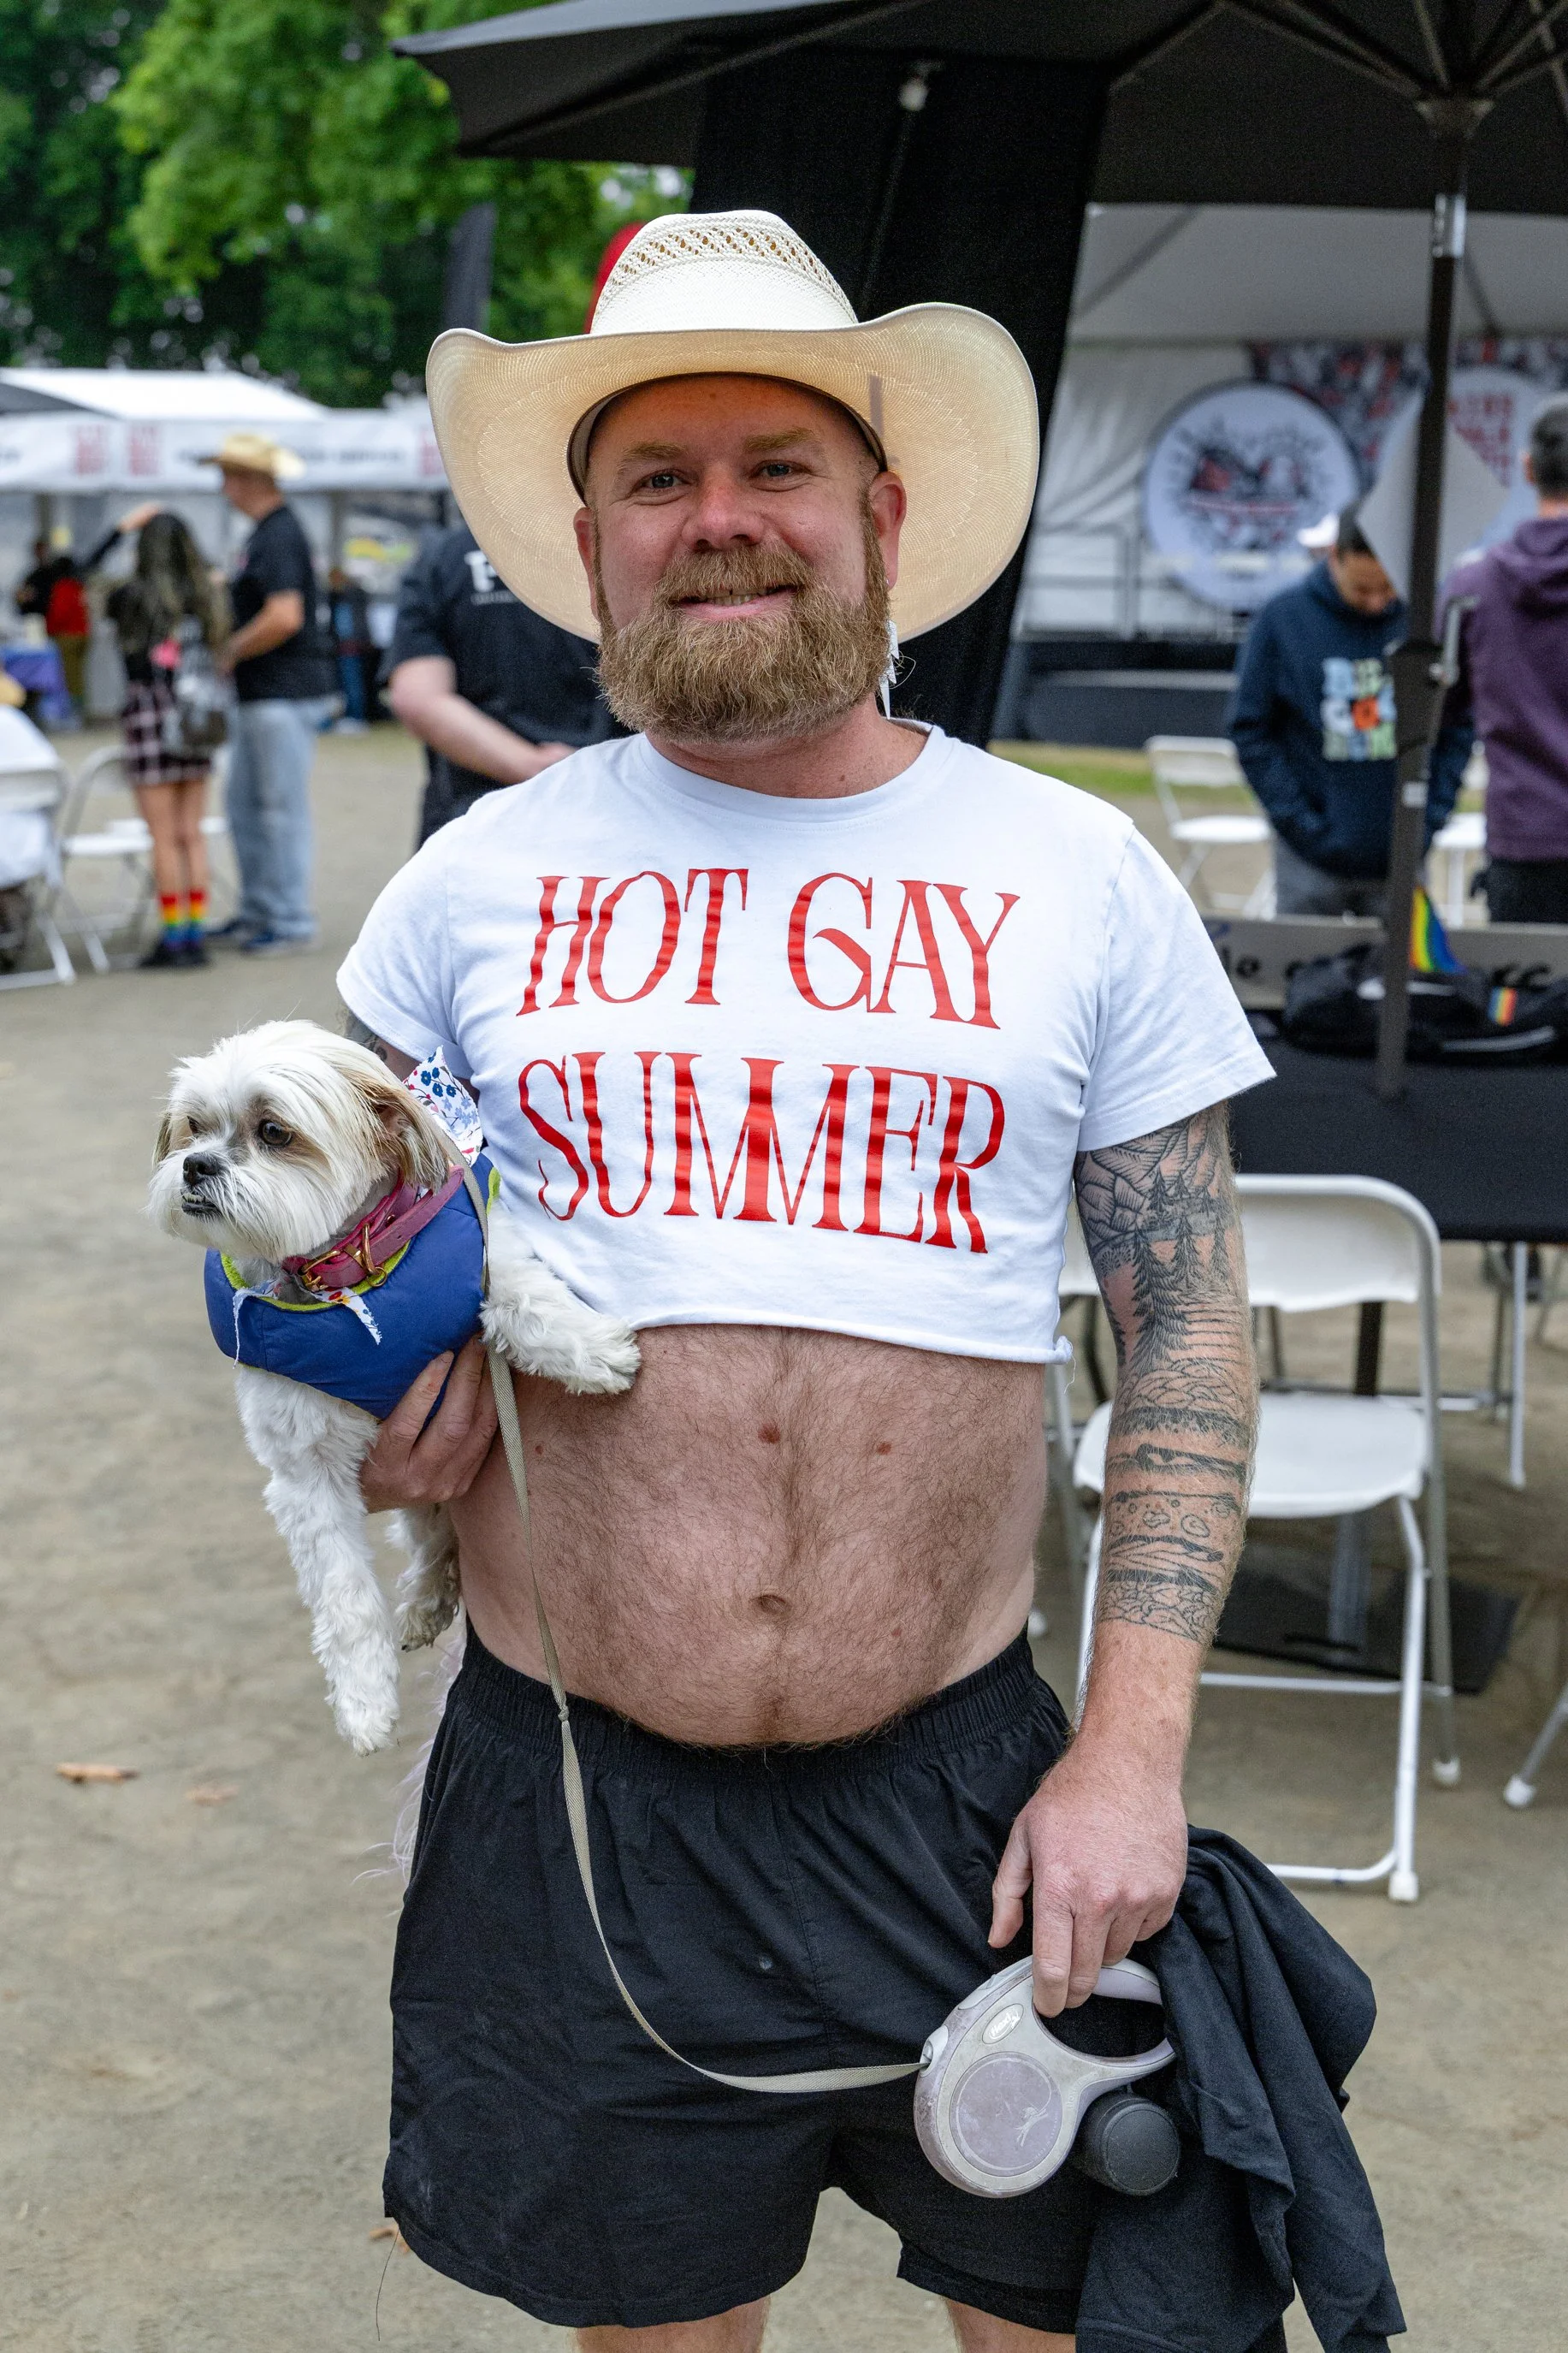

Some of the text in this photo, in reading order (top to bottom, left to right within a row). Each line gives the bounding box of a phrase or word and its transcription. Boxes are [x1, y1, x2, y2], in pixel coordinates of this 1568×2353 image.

[518, 868, 1019, 1028] HOT GAY
[519, 1052, 1004, 1253] SUMMER
